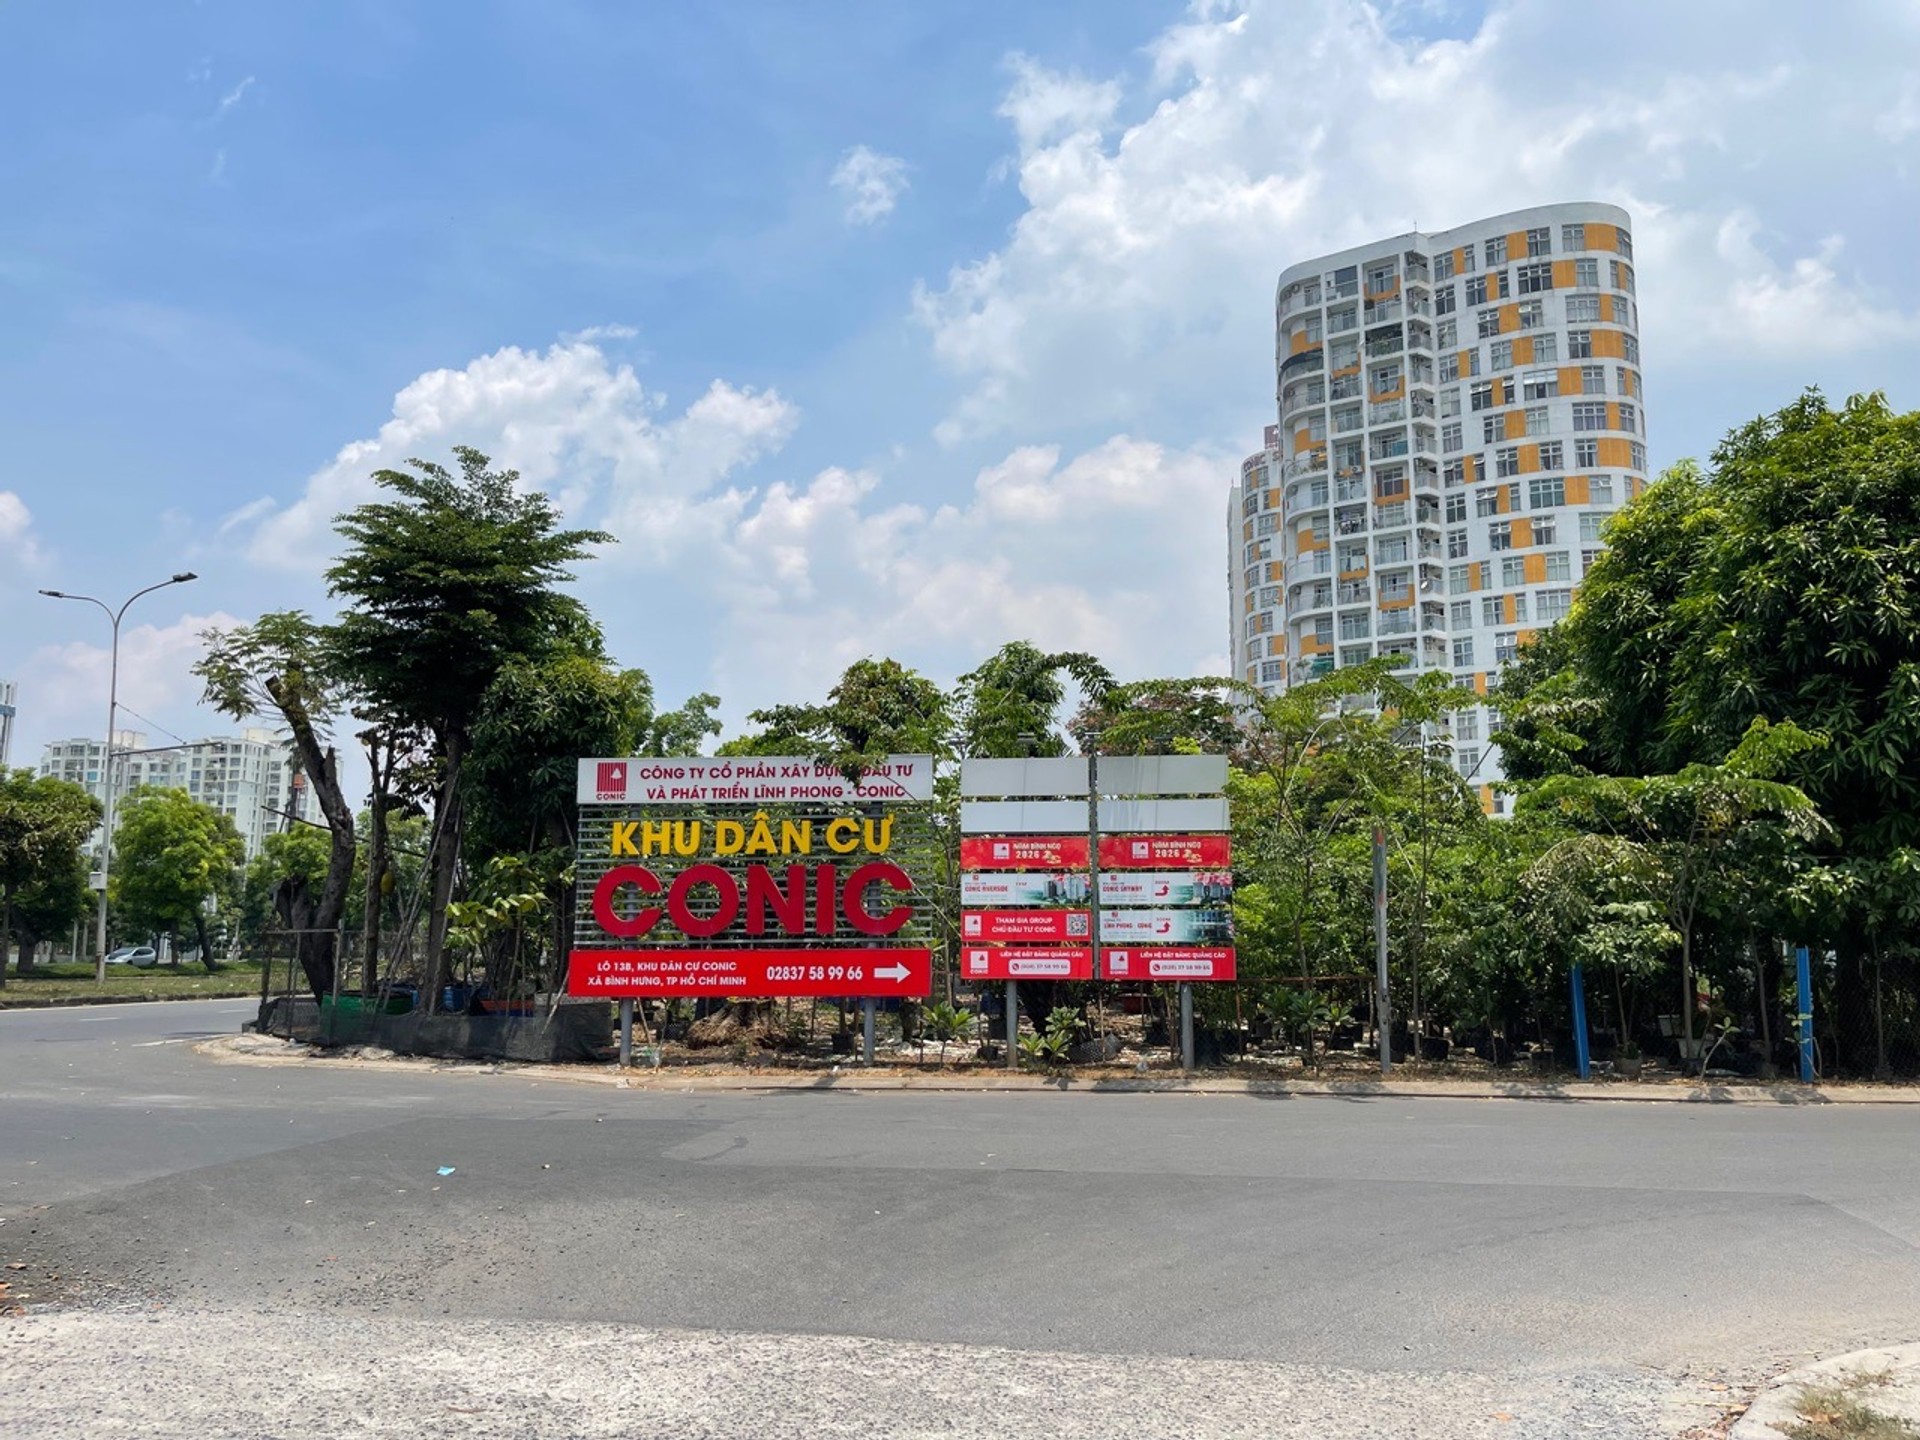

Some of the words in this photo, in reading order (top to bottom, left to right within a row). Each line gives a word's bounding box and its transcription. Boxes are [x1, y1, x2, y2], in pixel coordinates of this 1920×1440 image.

[640, 764, 685, 779] CÔNG
[689, 767, 705, 778] TY
[709, 761, 732, 779] CỔ
[736, 761, 776, 778] PHẦN
[781, 763, 810, 778] XÂY
[896, 763, 913, 777] TƯ
[596, 793, 626, 801] CONIC
[646, 785, 666, 799] VÀ
[671, 784, 707, 799] PHÁT
[711, 781, 749, 799] TRIỂN
[754, 784, 786, 798] LĨNH
[790, 785, 843, 798] PHONG
[856, 785, 906, 798] CONIC
[611, 820, 701, 856] KHU
[715, 811, 812, 856] DÂN
[826, 813, 895, 854] CƯ
[1016, 850, 1040, 859] 2026
[1155, 849, 1180, 858] 2026
[593, 861, 914, 937] CONIC
[995, 916, 1015, 924] THAM
[1016, 916, 1029, 924] GIA
[1029, 916, 1053, 924] GROUP
[597, 960, 612, 972] LÔ
[614, 961, 634, 973] 13B,
[637, 961, 659, 972] KHU
[660, 960, 683, 972] DÂN
[684, 961, 701, 972] CƯ
[702, 961, 738, 972] CONIC
[766, 966, 805, 980] 02837
[808, 966, 825, 980] 58
[827, 966, 844, 980] 99
[847, 966, 863, 980] 66
[587, 975, 602, 986] XÃ
[604, 975, 629, 986] BÌNH
[631, 976, 664, 987] HƯNG,
[666, 976, 678, 986] TP
[680, 973, 697, 986] HỒ
[698, 974, 718, 986] CHÍ
[719, 976, 747, 986] MINH
